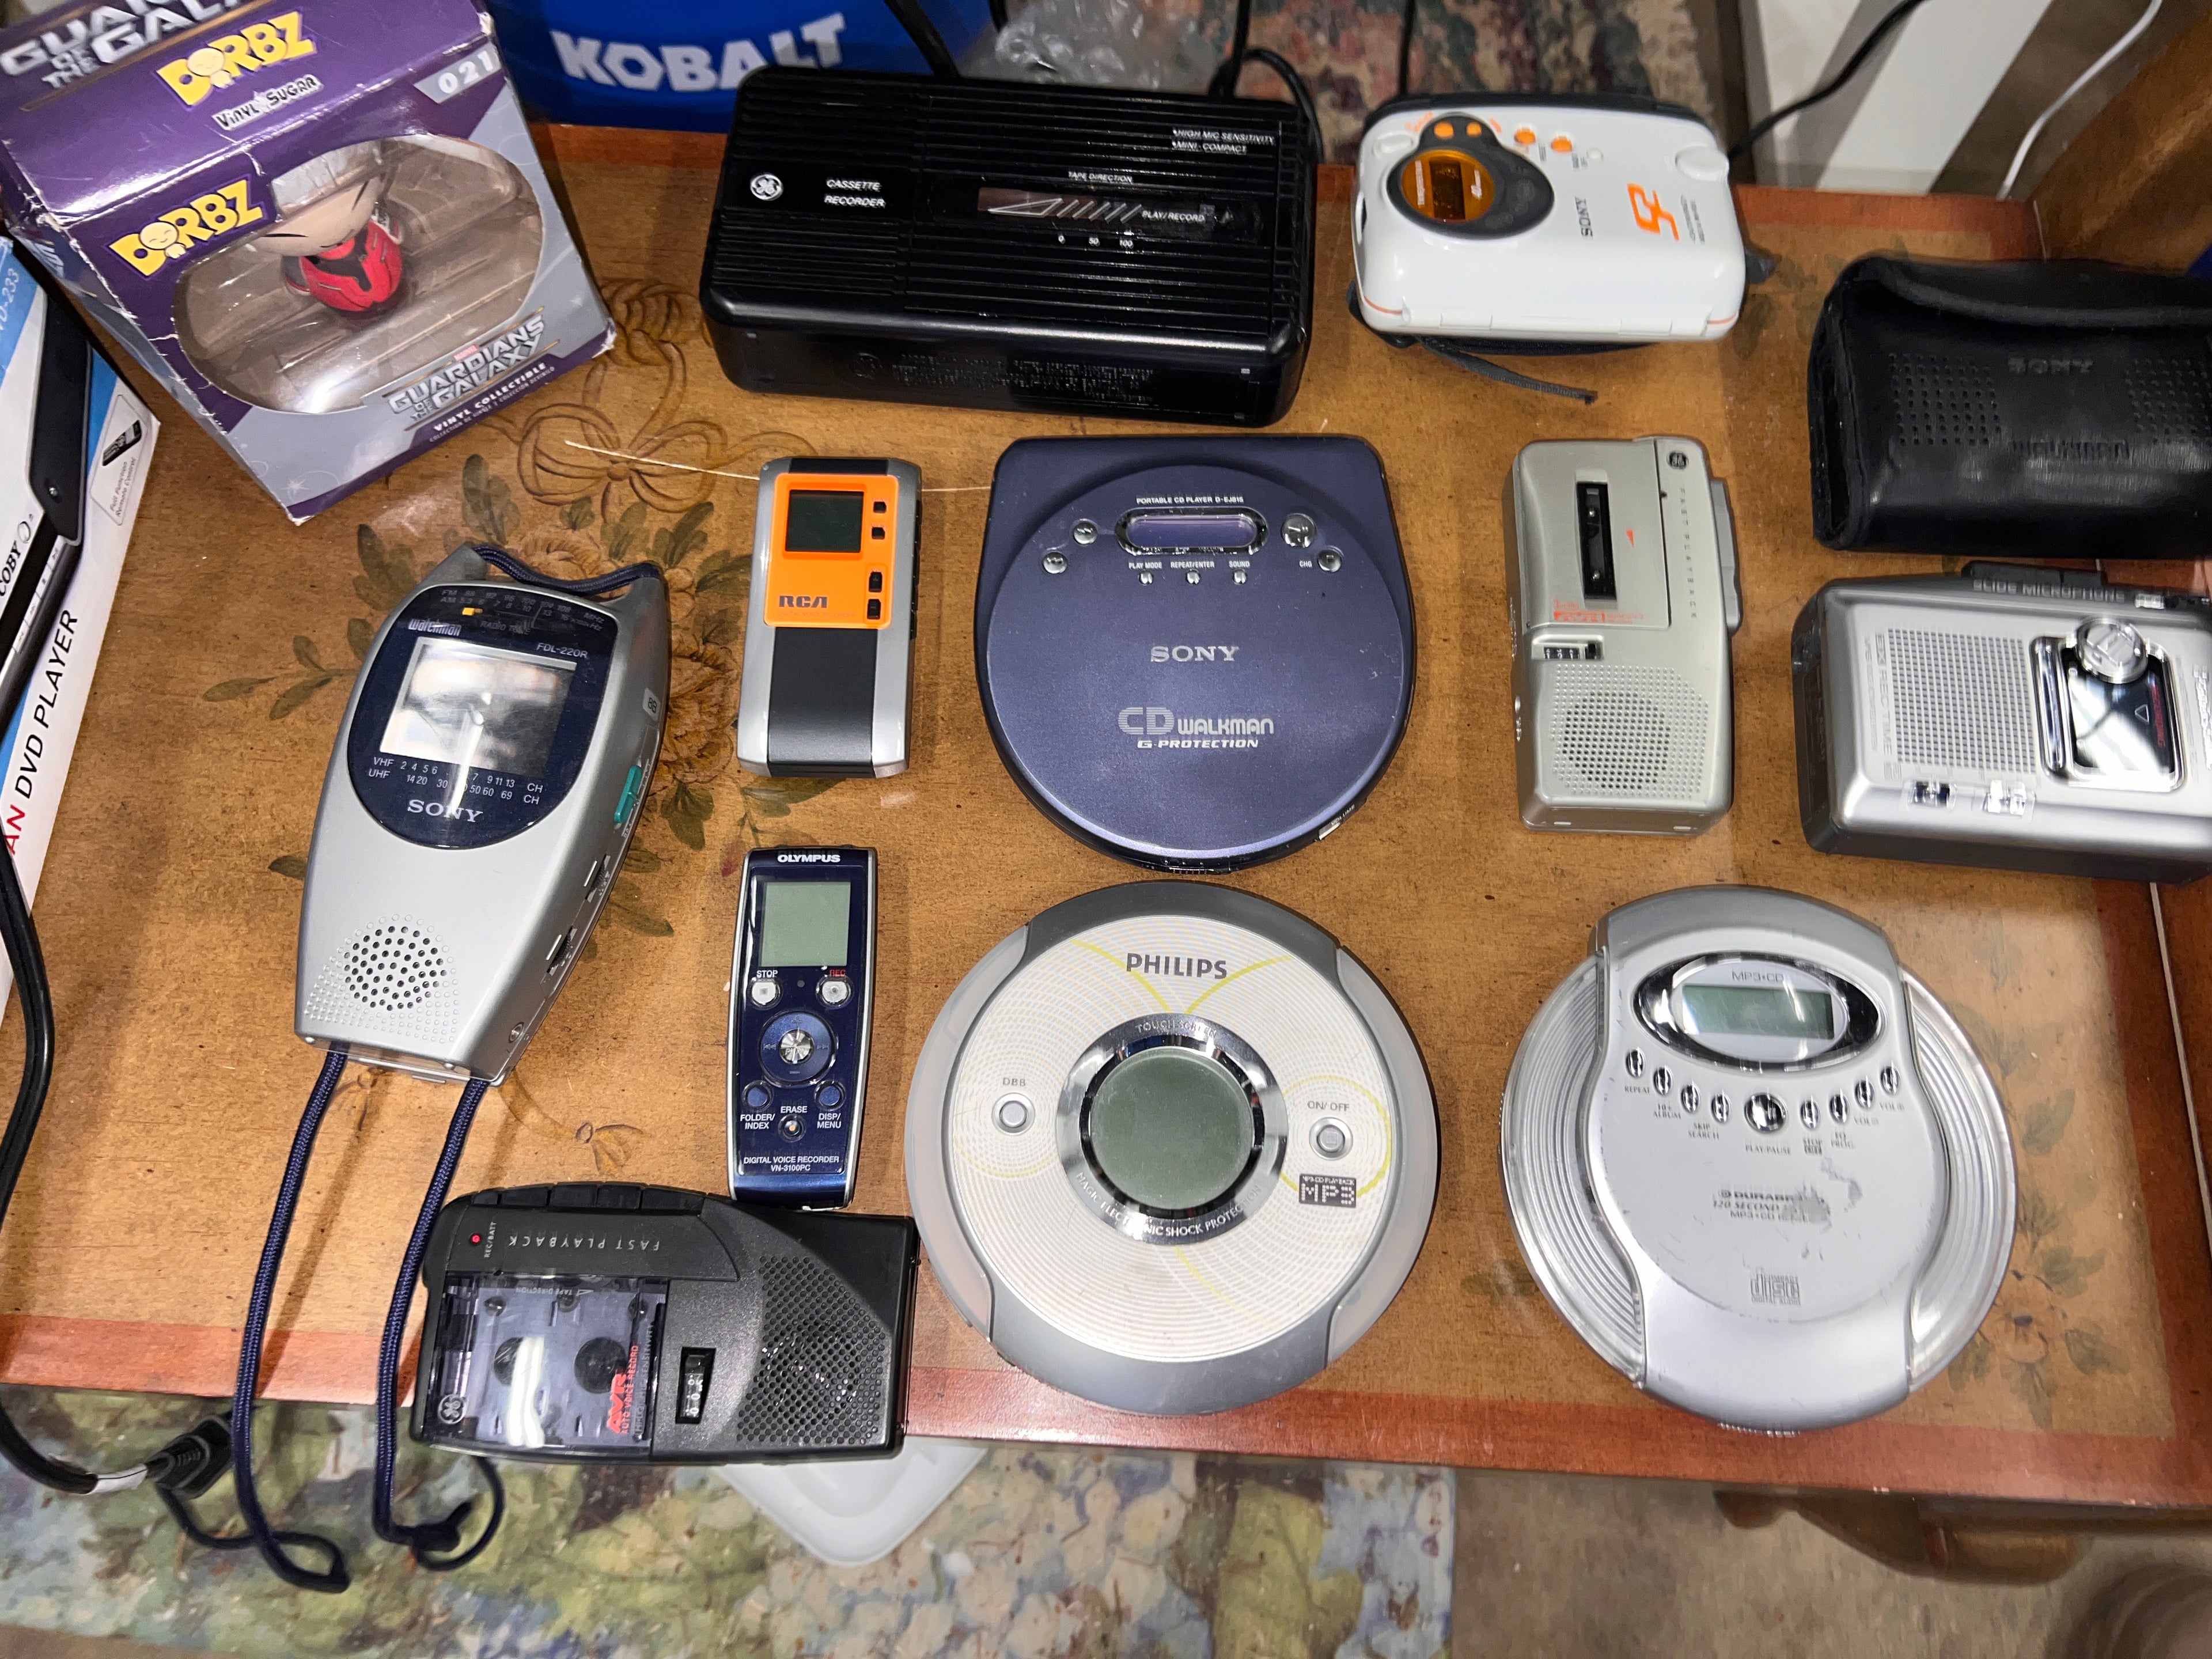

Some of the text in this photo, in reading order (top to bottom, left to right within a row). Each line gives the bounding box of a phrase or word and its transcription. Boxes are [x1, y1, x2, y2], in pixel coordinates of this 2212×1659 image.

[549, 13, 846, 92] KOBALT
[438, 51, 494, 93] 021
[267, 77, 317, 107] SUGAR
[826, 179, 881, 192] CASSETTE
[1089, 173, 1133, 184] DIRECTION
[824, 195, 886, 208] RECORDER
[1575, 195, 1593, 238] SONY
[389, 314, 546, 413] GUARDIANS
[433, 332, 542, 409] GALAXY
[434, 362, 546, 432] VINYL COLLECTIBLE
[1137, 496, 1172, 505] PORTABLE
[1174, 496, 1184, 504] CD
[1186, 496, 1213, 504] PLAYER
[1128, 560, 1162, 570] PLAY MODE
[1171, 560, 1215, 569] REPEAT/ENTER
[1229, 560, 1251, 568] SOUND
[1299, 560, 1313, 568] CHG
[779, 594, 828, 609] RCA
[536, 642, 589, 659] FDL-220R
[1150, 645, 1239, 662] SONY
[15, 733, 44, 800] DVD
[33, 607, 78, 729] PLAYER
[1118, 707, 1175, 735] CD
[1137, 739, 1259, 749] G-PROTECTION
[373, 756, 543, 794] VHF 2 4 5 6 7 9 11 13 CH
[368, 768, 540, 805] UHF 14 20 30 50 60 69 CH
[407, 798, 484, 823] SONY
[777, 854, 841, 863] OLYMPUS
[1126, 952, 1228, 979] PHILIPS
[756, 970, 778, 979] STOP
[829, 969, 846, 978] REC
[1002, 1077, 1027, 1087] DBB
[781, 1105, 808, 1113] ERASE
[740, 1113, 776, 1122] FOLDER/
[817, 1120, 842, 1129] MENU
[819, 1113, 842, 1121] DISP/
[745, 1122, 770, 1130] INDEX
[797, 1156, 839, 1164] RECORDER
[1301, 1183, 1355, 1205] MP3
[1076, 1171, 1102, 1204] MAGIC
[1165, 1223, 1202, 1237] SHOCK
[1205, 1184, 1263, 1232] PROTECTION
[483, 1221, 497, 1259] REC/BATT
[509, 1236, 660, 1251] FAST PLAYBACK
[555, 1288, 574, 1296] TAPE
[606, 1373, 627, 1434] AVR
